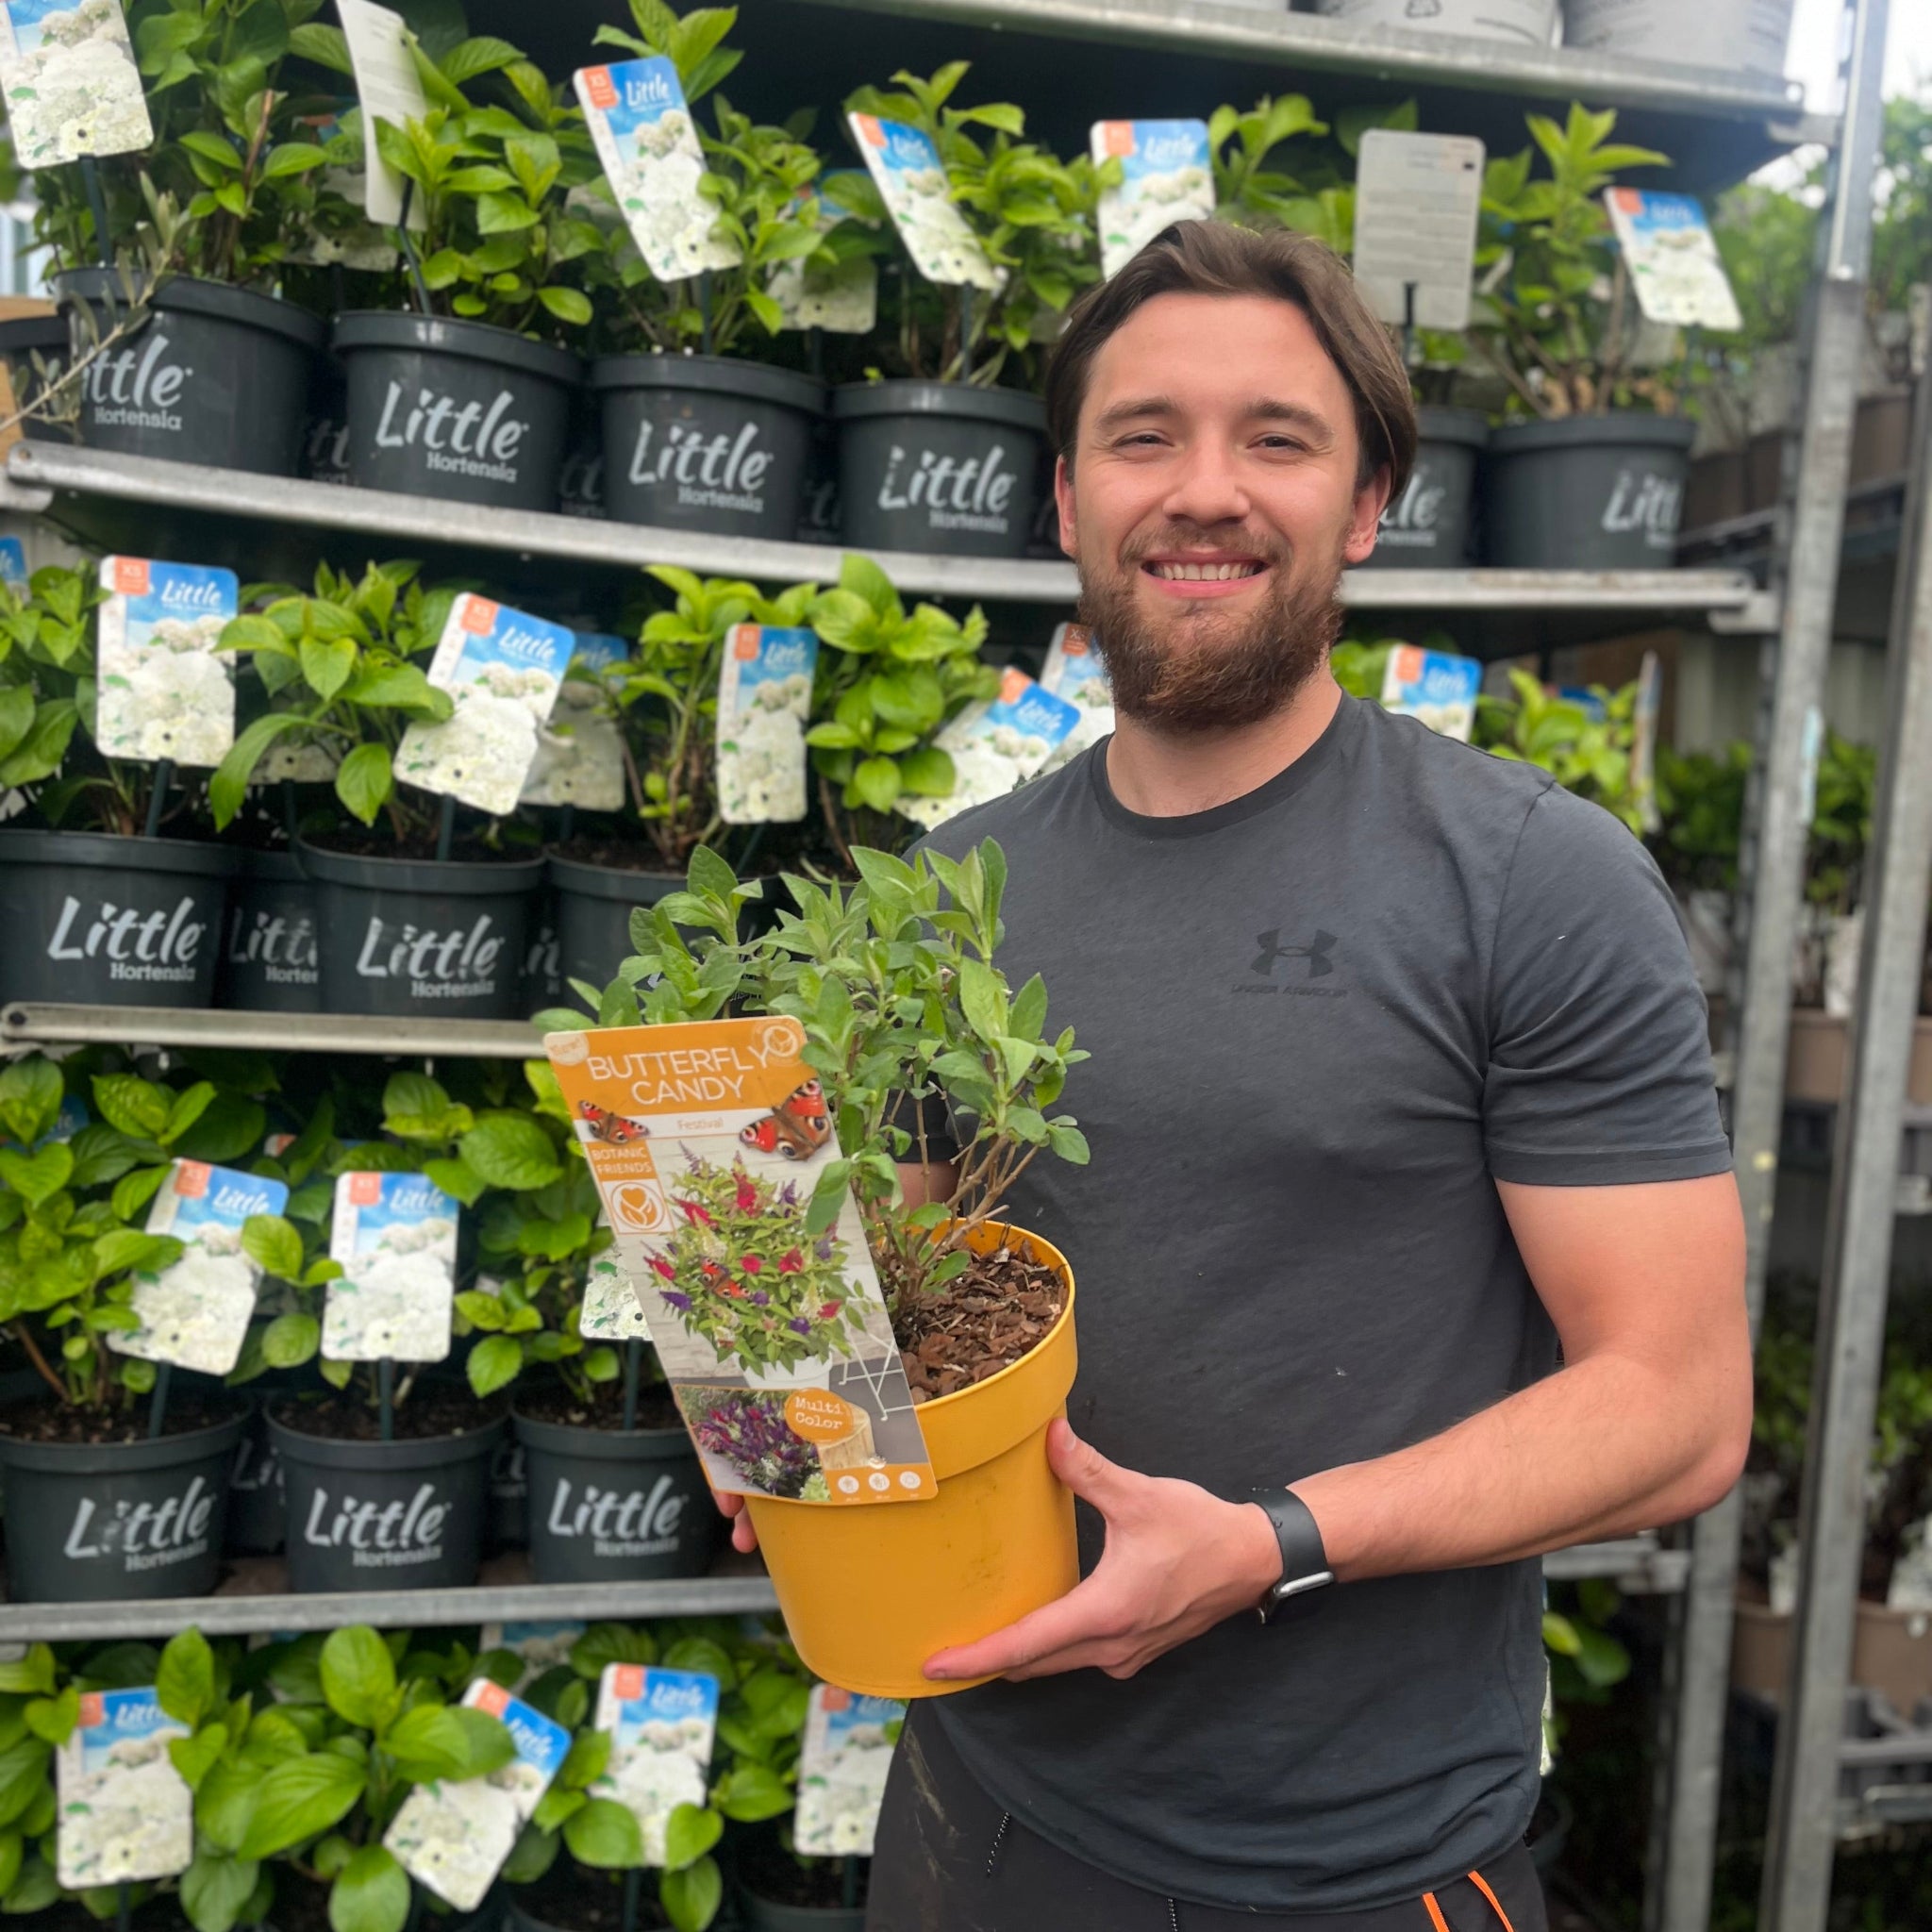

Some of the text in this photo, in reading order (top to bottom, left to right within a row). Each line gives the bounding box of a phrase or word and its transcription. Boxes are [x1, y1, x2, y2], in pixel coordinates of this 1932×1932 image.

[625, 73, 669, 107] Little
[81, 334, 186, 408] ittle
[95, 406, 182, 431] Hortensia
[375, 380, 521, 460] Little
[426, 451, 518, 483] Hortensia
[628, 420, 769, 491] Little
[878, 445, 1012, 513] Little
[677, 486, 764, 513] Hortensia
[161, 578, 222, 606] Little
[498, 625, 556, 659] Little
[48, 895, 200, 964] Little
[357, 914, 500, 979] Little
[110, 962, 195, 981] Hortensia
[586, 1045, 770, 1080] BUTTERFLY
[631, 1074, 744, 1105] CANDY
[677, 1118, 724, 1130] Festival
[591, 1146, 648, 1160] BOTANIC
[596, 1161, 652, 1176] FRIENDS
[213, 1186, 270, 1214] Little
[390, 1188, 444, 1212] Little
[795, 1396, 844, 1415] Multi
[795, 1412, 842, 1430] Color
[63, 1475, 212, 1558] Little
[305, 1484, 444, 1549] Little
[547, 1475, 682, 1540] Little
